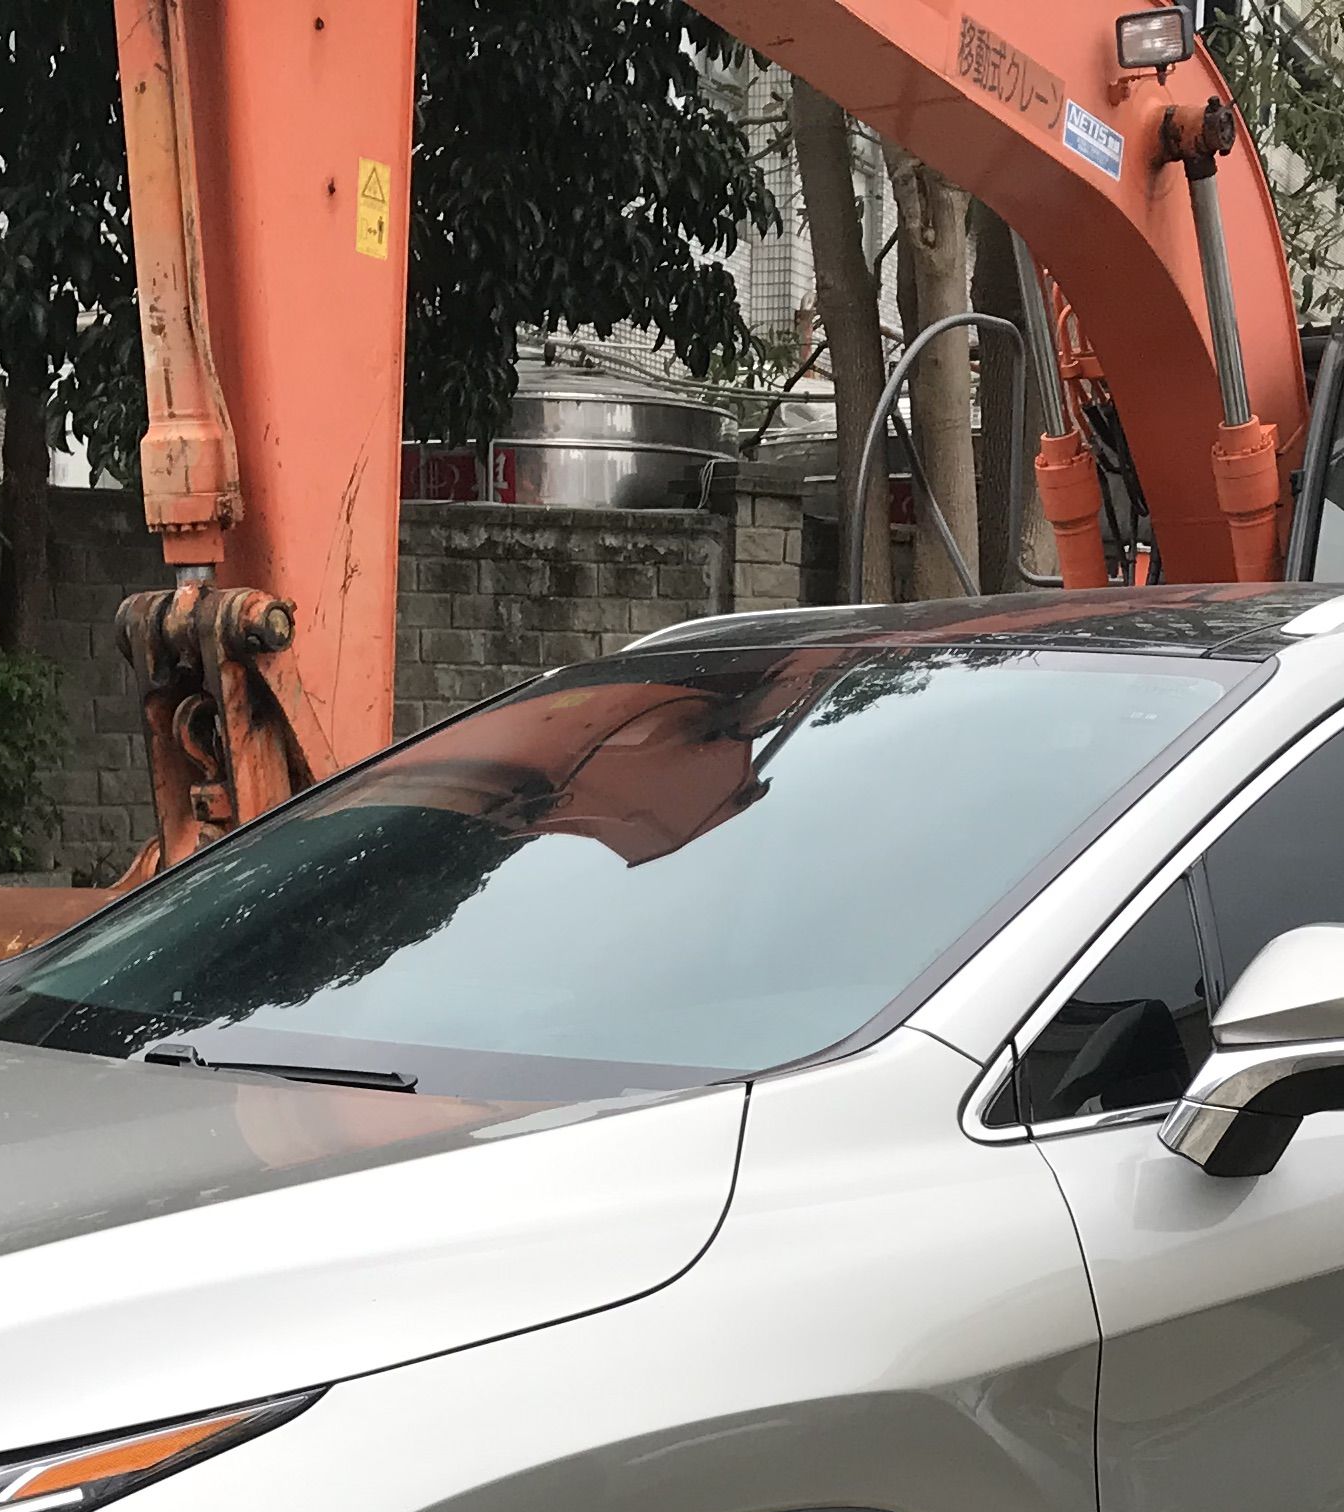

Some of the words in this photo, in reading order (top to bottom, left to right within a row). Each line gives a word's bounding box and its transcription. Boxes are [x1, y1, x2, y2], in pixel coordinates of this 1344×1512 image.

[958, 15, 1064, 129] 移動式クレーン
[1068, 104, 1109, 146] NETIS
